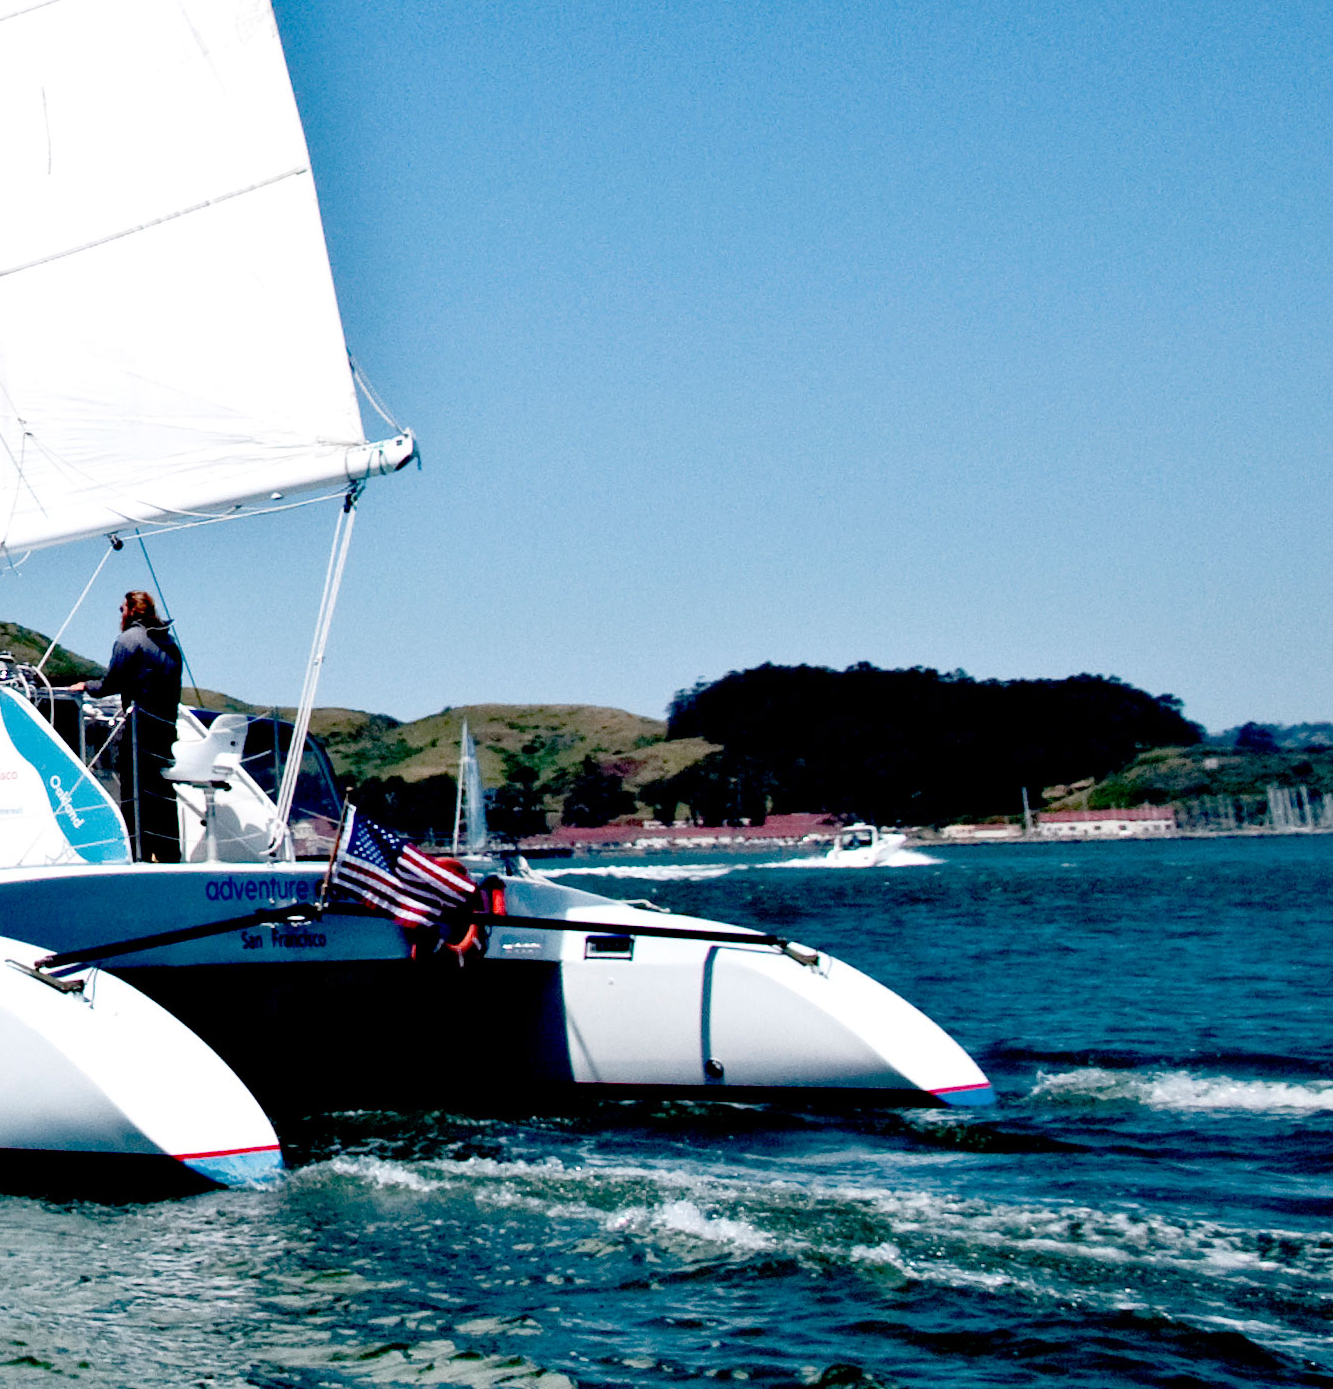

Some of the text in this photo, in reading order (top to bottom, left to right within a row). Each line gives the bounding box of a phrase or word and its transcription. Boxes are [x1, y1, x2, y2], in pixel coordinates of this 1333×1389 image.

[50, 774, 85, 829] Oakland
[205, 875, 309, 901] adventure
[240, 927, 327, 950] San Francisco
